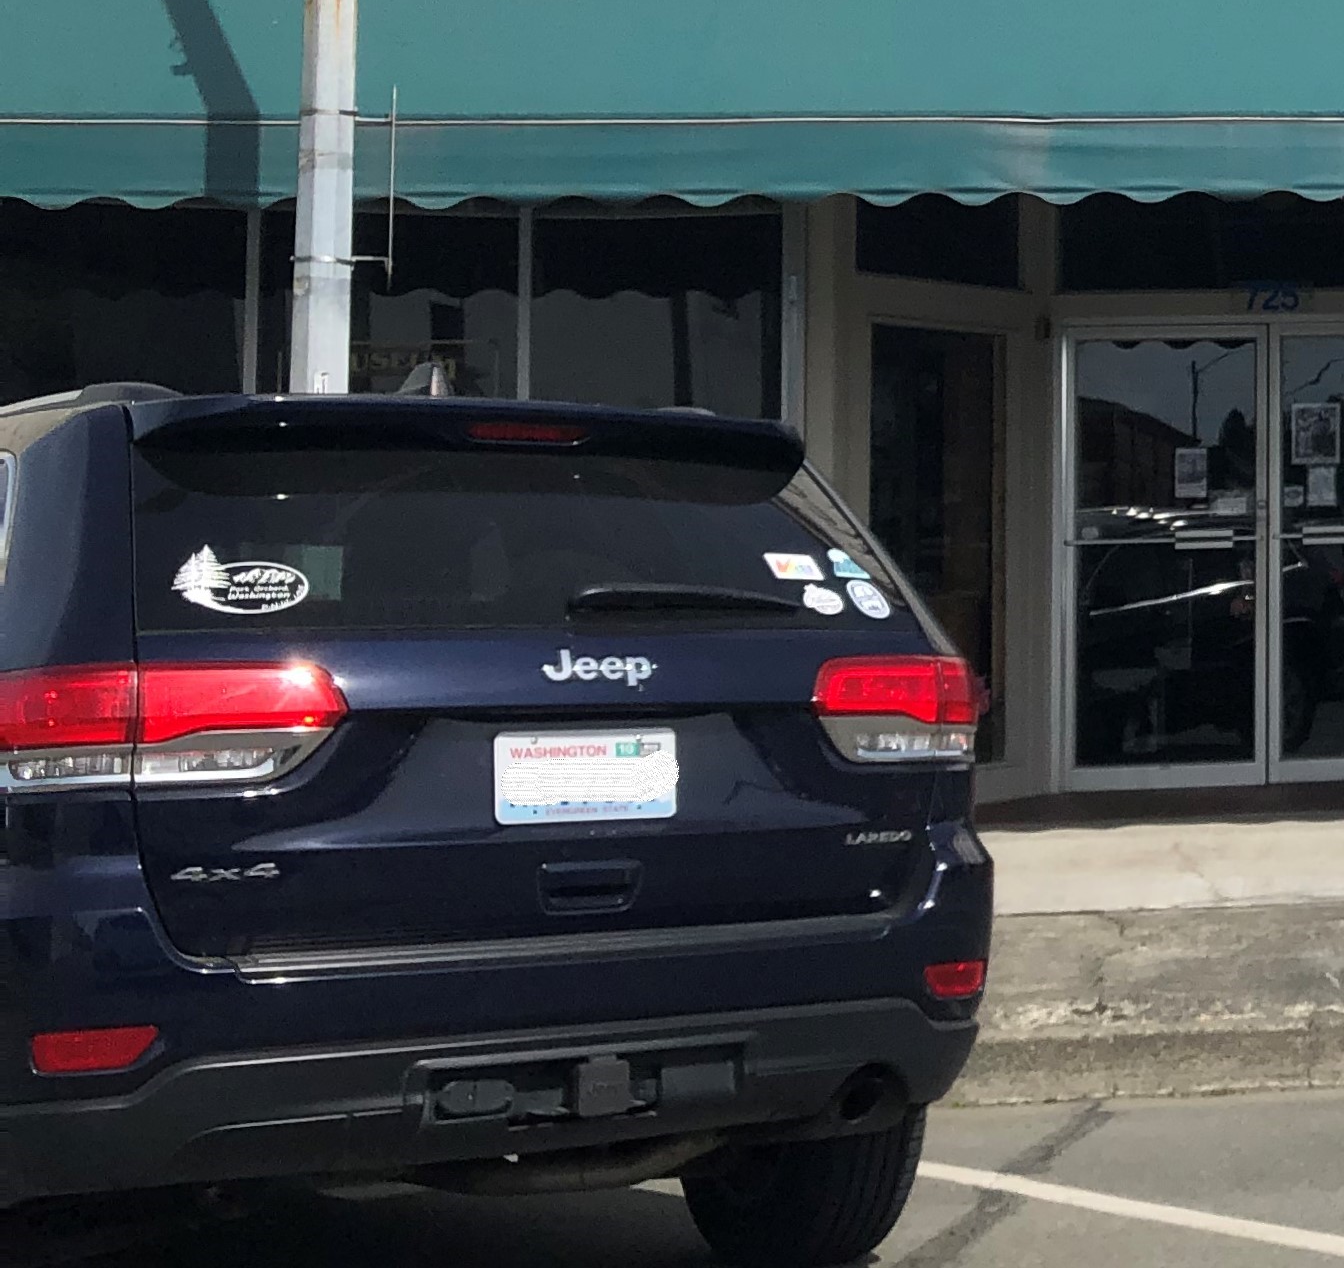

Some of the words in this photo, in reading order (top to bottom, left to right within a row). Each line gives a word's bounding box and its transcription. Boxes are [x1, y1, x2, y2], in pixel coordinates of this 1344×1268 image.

[1245, 282, 1299, 310] 725
[541, 649, 652, 686] Jeep
[509, 744, 607, 759] WASHINGTON
[845, 830, 912, 845] LAREDO
